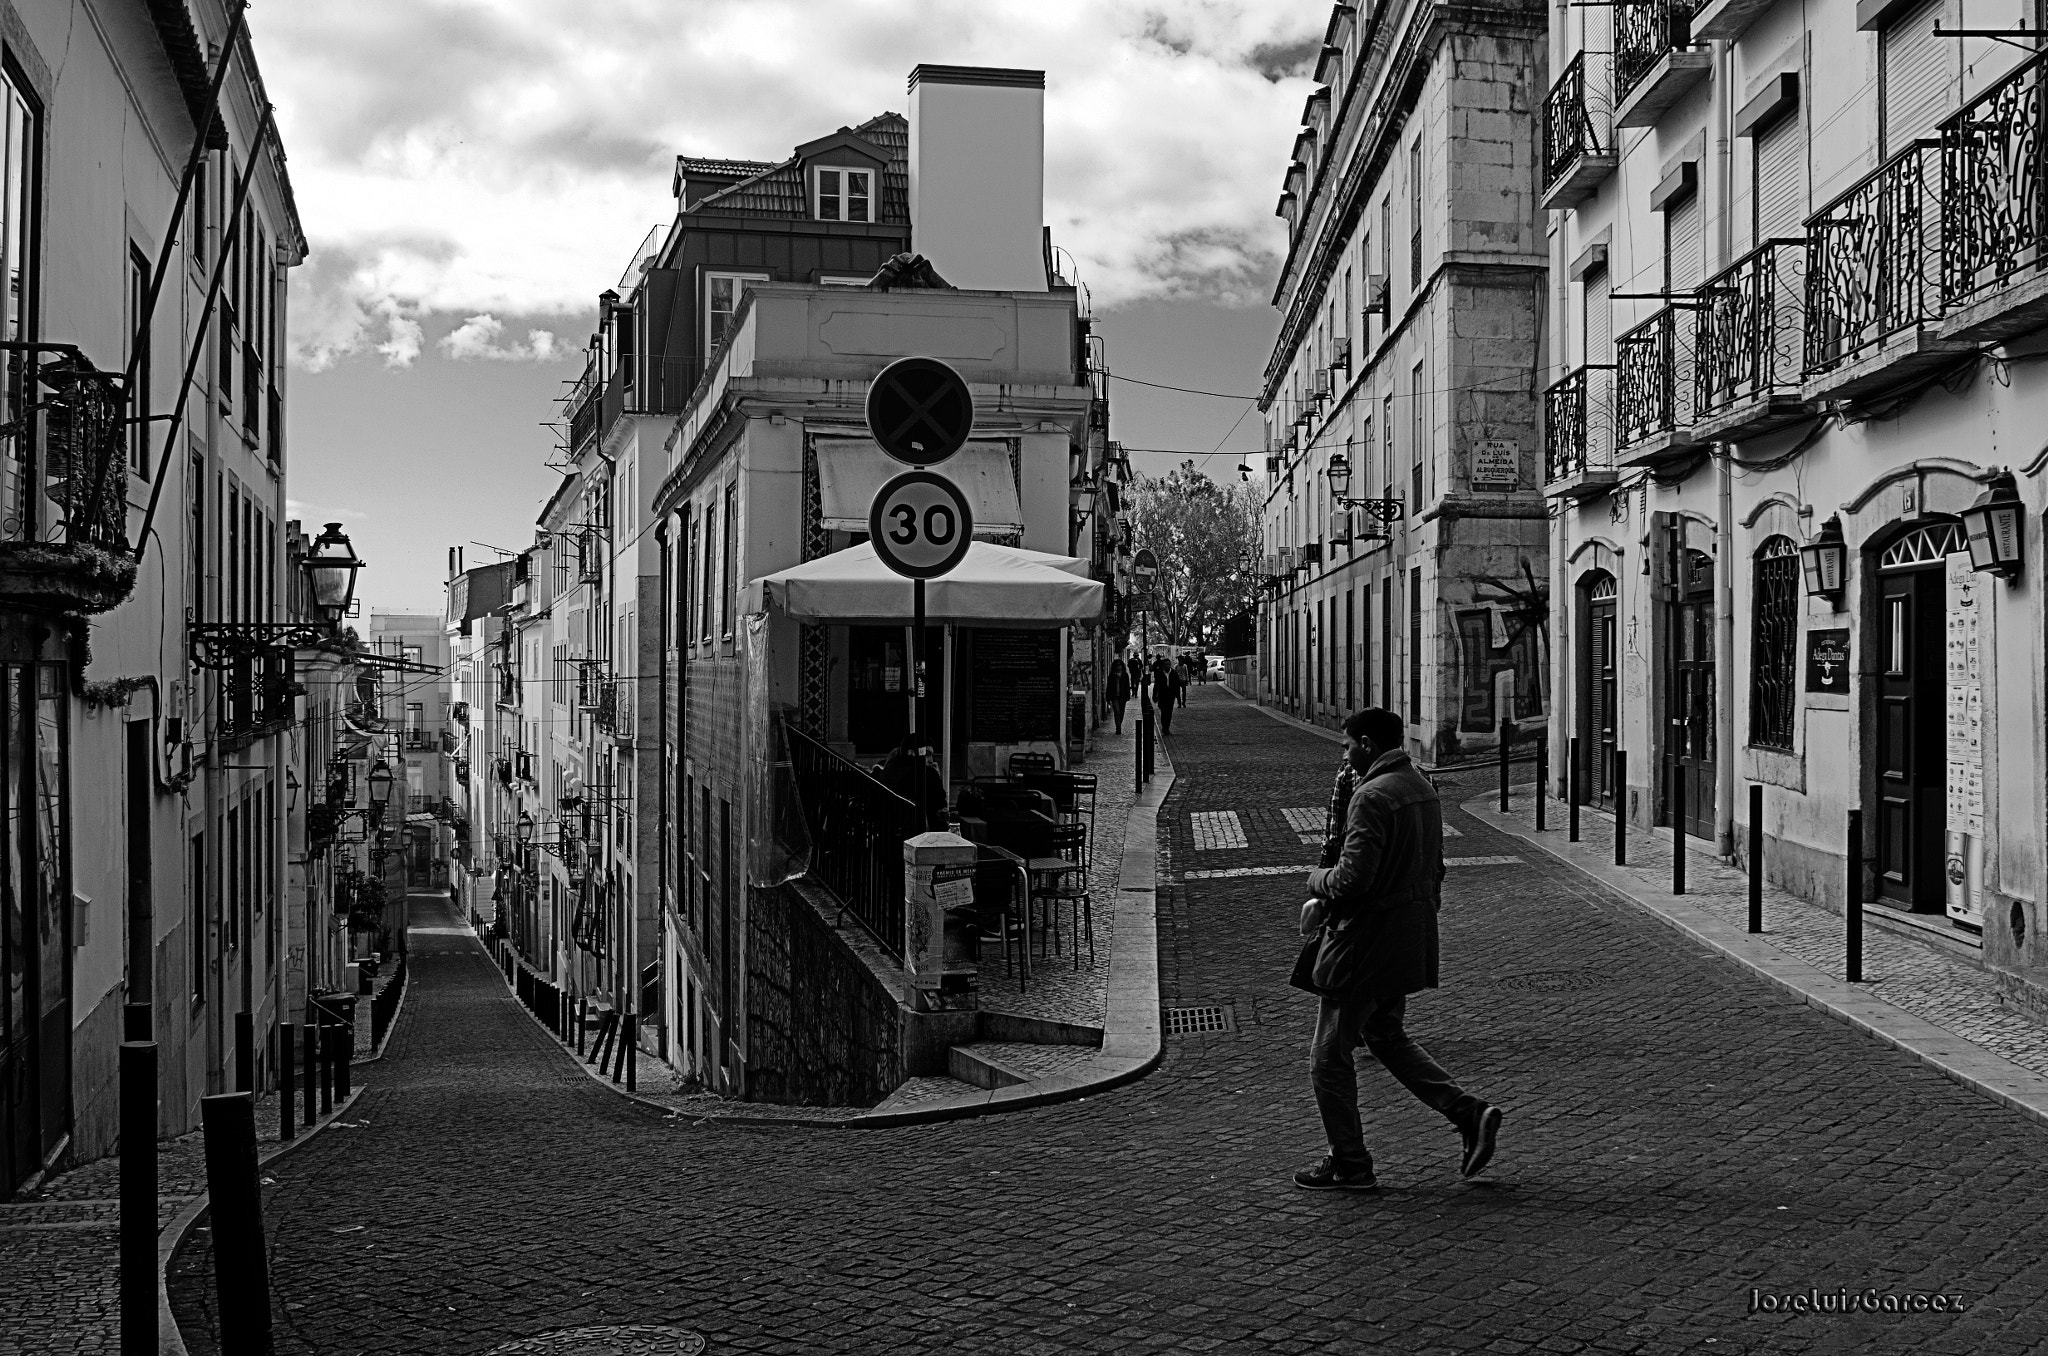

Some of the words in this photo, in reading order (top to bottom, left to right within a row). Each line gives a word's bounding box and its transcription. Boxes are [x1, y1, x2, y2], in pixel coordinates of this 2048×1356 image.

[1476, 467, 1516, 475] ALBUQUERQUE
[888, 503, 956, 546] 30
[1998, 513, 2011, 558] RESTAURANTE
[1824, 551, 1835, 587] RESTAURANTE
[1812, 647, 1827, 663] Adega
[1827, 647, 1845, 661] Dantas
